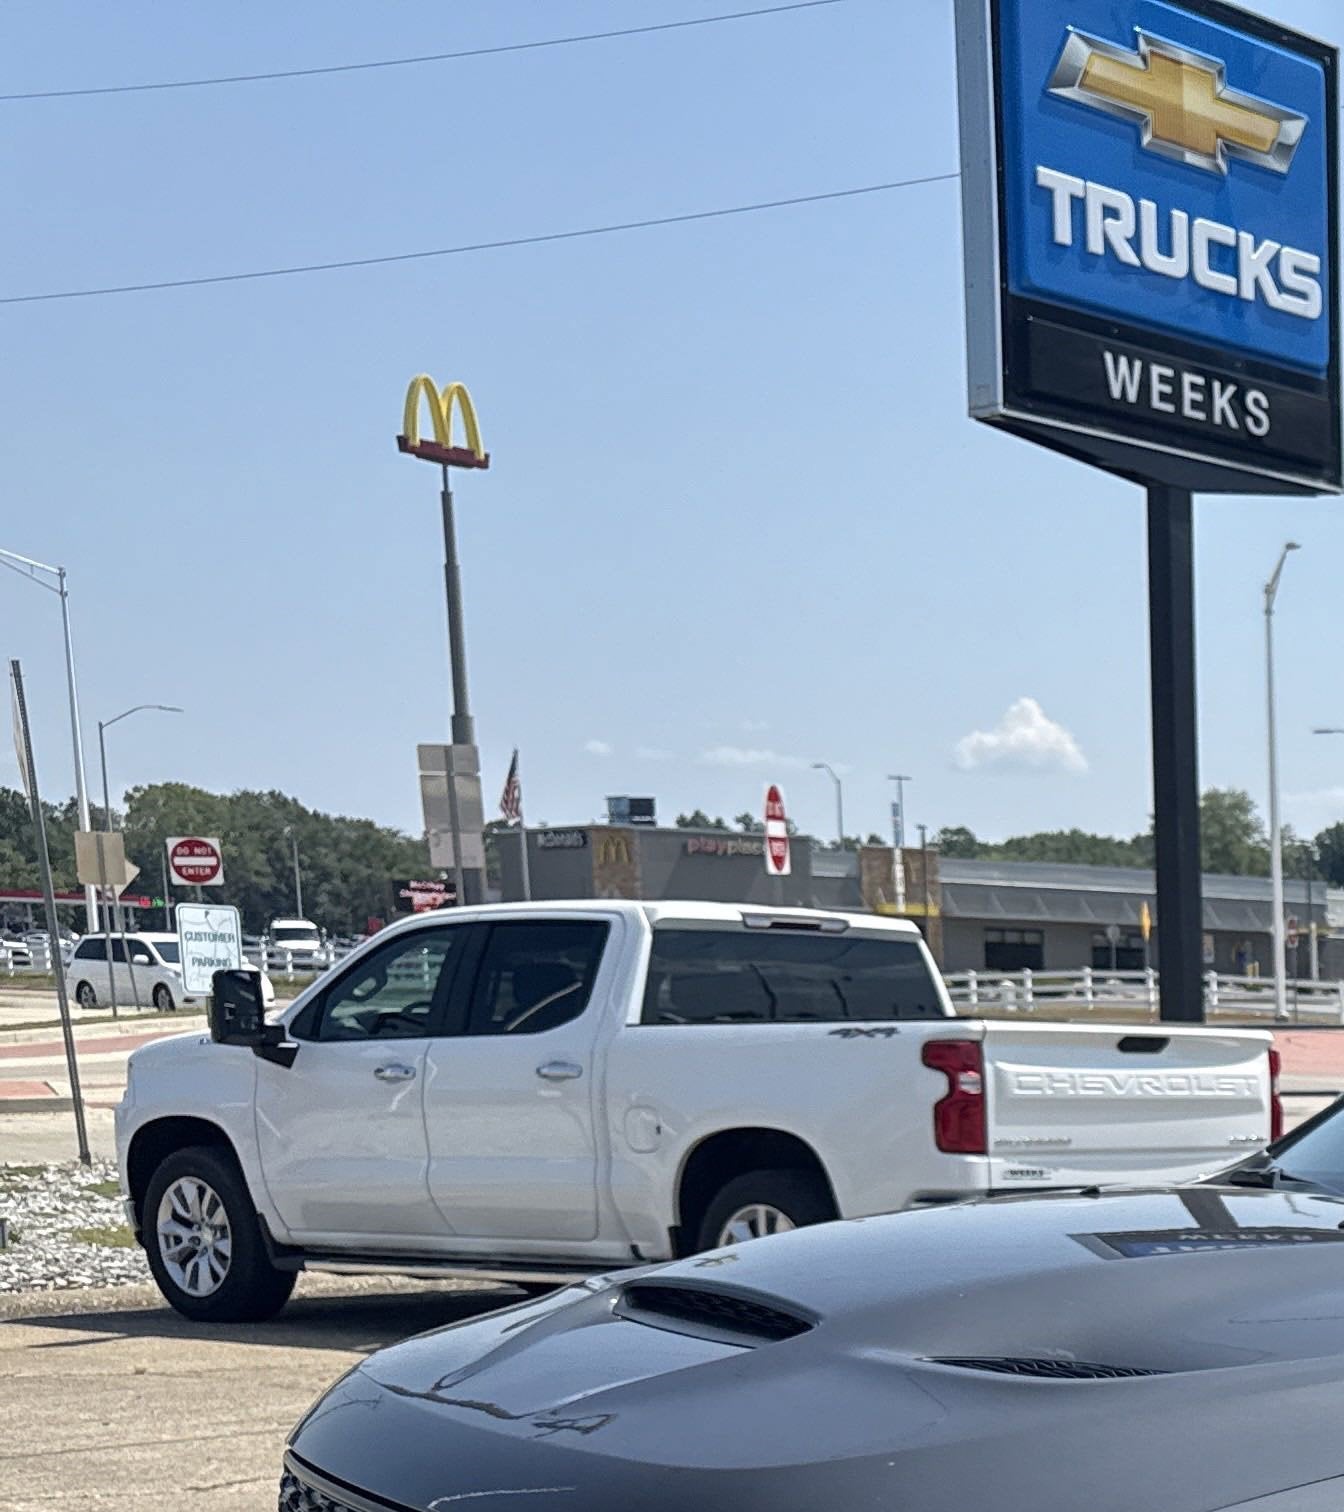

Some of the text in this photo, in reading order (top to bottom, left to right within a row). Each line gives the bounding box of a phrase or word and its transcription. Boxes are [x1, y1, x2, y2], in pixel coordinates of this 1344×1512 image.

[1036, 165, 1323, 321] TRUCKS
[1103, 350, 1271, 438] WEEKS
[176, 846, 190, 856] DO
[181, 865, 212, 876] ENTER
[184, 930, 235, 944] CUSTOMER
[191, 956, 232, 969] PARKING
[1012, 1072, 1258, 1097] CHEVROLET
[1008, 1168, 1043, 1178] WEEKS
